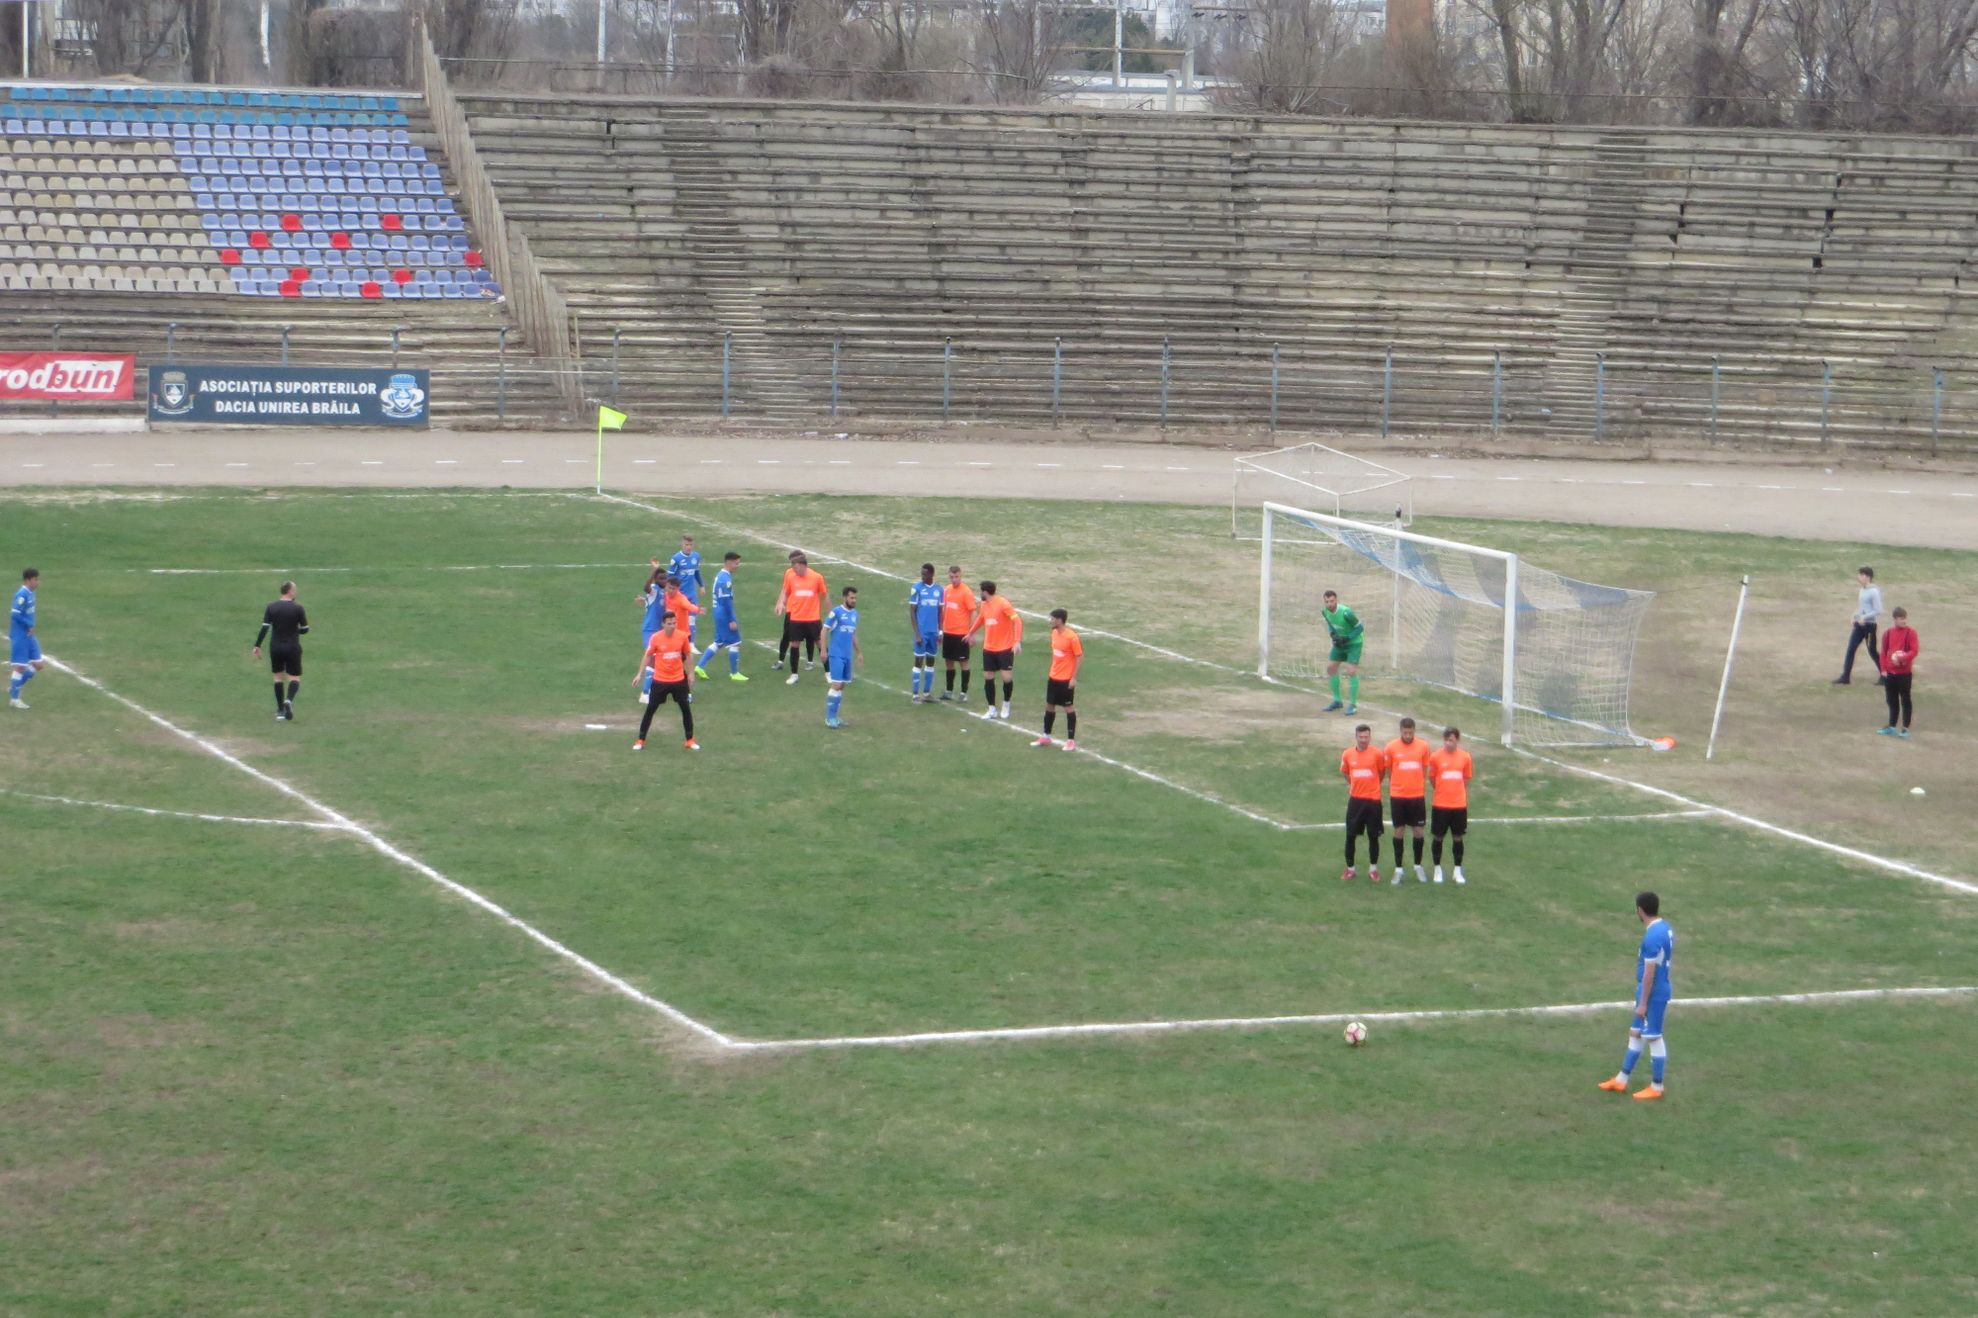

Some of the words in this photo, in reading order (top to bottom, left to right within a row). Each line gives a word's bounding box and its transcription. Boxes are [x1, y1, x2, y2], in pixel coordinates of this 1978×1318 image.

[275, 381, 377, 395] SUPORTERILOR
[215, 400, 256, 413] DACIA
[258, 401, 310, 414] UNIREA
[311, 399, 361, 415] BRĂILA
